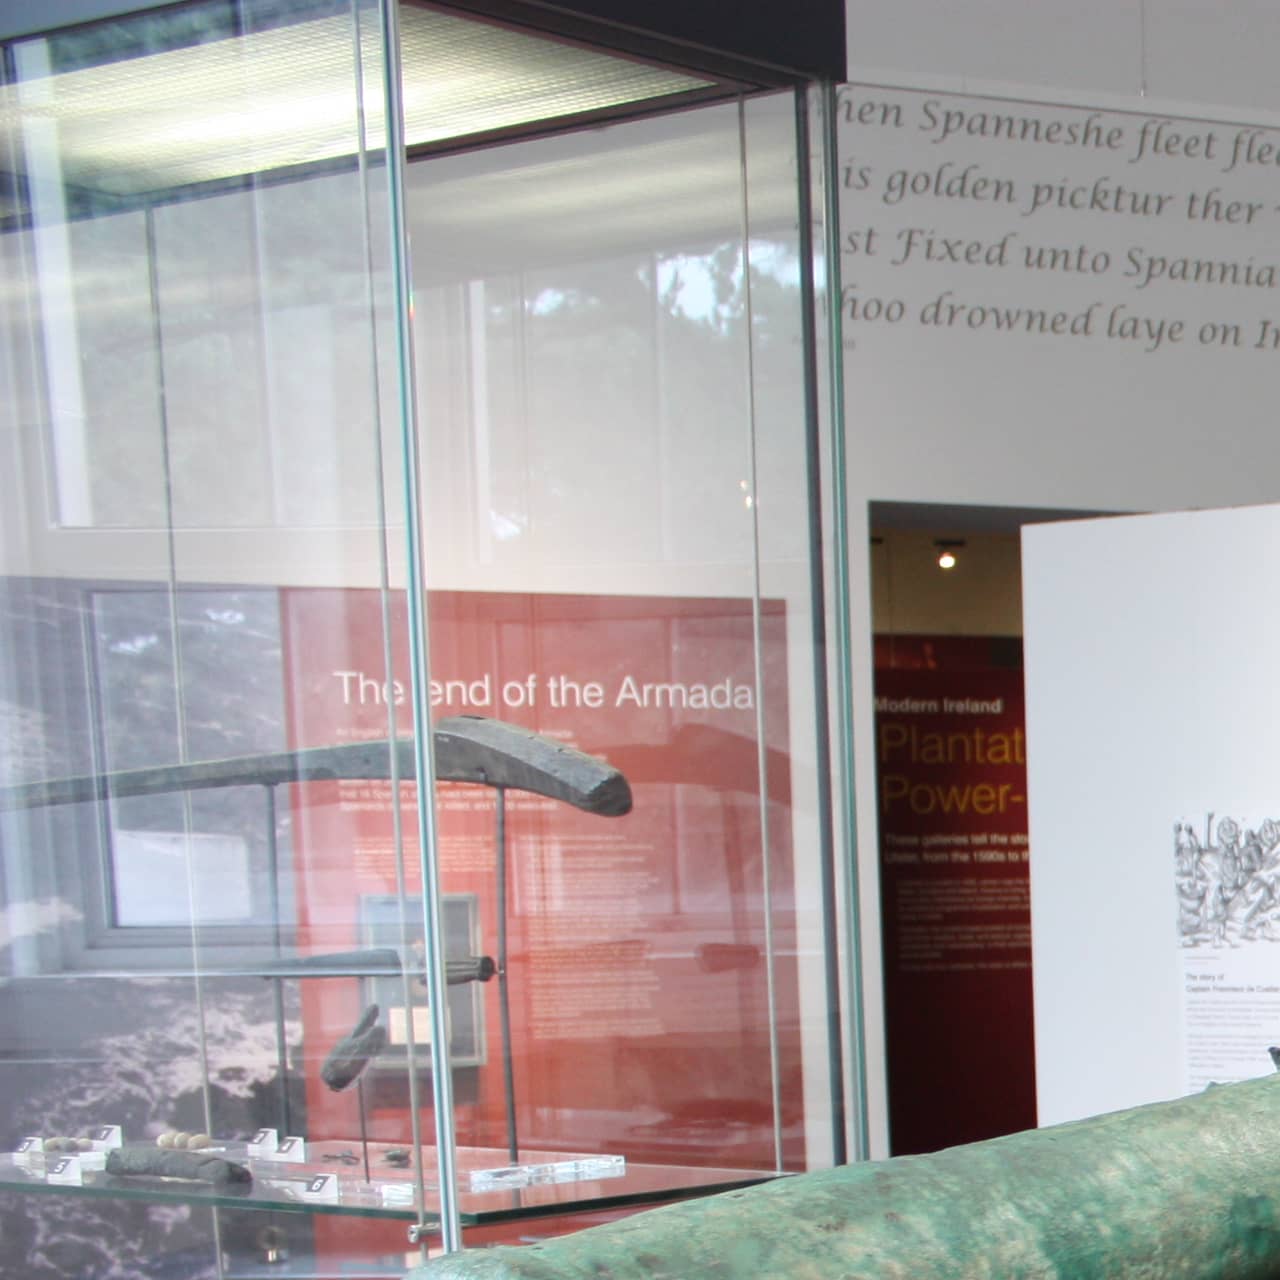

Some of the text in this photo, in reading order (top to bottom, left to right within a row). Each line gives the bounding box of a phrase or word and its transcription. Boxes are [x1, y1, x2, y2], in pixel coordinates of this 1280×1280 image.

[836, 87, 904, 128] hen
[918, 98, 1124, 150] Spanneshe
[1129, 120, 1217, 163] fleet
[843, 157, 872, 190] is
[882, 162, 1016, 204] golden
[1022, 176, 1174, 216] picktur
[1186, 184, 1263, 226] ther
[844, 226, 878, 257] st
[891, 227, 1016, 269] Fixed
[1023, 239, 1112, 276] unto
[840, 284, 905, 323] hoo
[918, 290, 1102, 338] drowned
[1105, 302, 1185, 351] laye
[1198, 321, 1243, 348] on
[333, 671, 754, 710] The end of the Armada
[875, 697, 1002, 714] Modern Ireland
